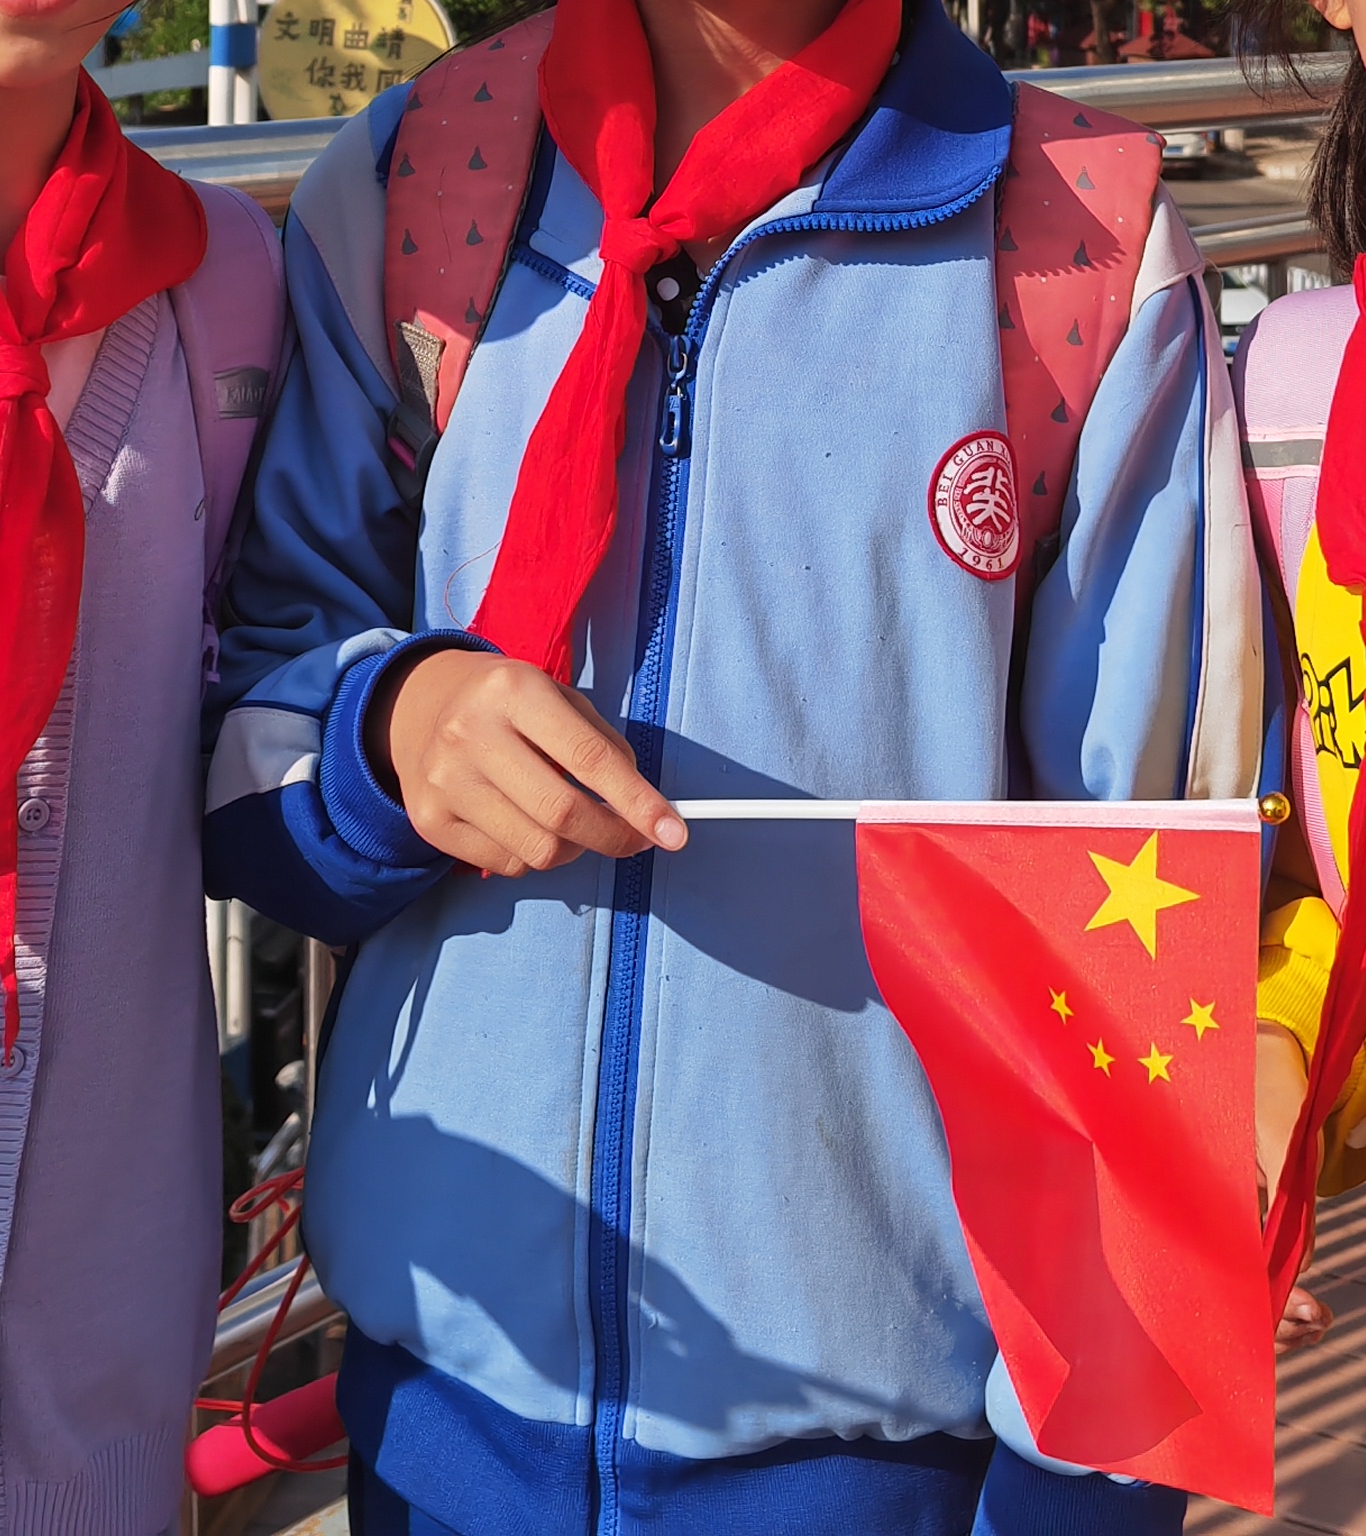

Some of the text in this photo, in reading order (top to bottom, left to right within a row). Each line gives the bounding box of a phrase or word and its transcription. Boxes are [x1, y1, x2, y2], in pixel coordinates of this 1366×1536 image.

[274, 10, 406, 61] 文明曲靖
[936, 474, 953, 507] BEI
[953, 439, 995, 467] GUAN
[957, 547, 1004, 571] 1961
